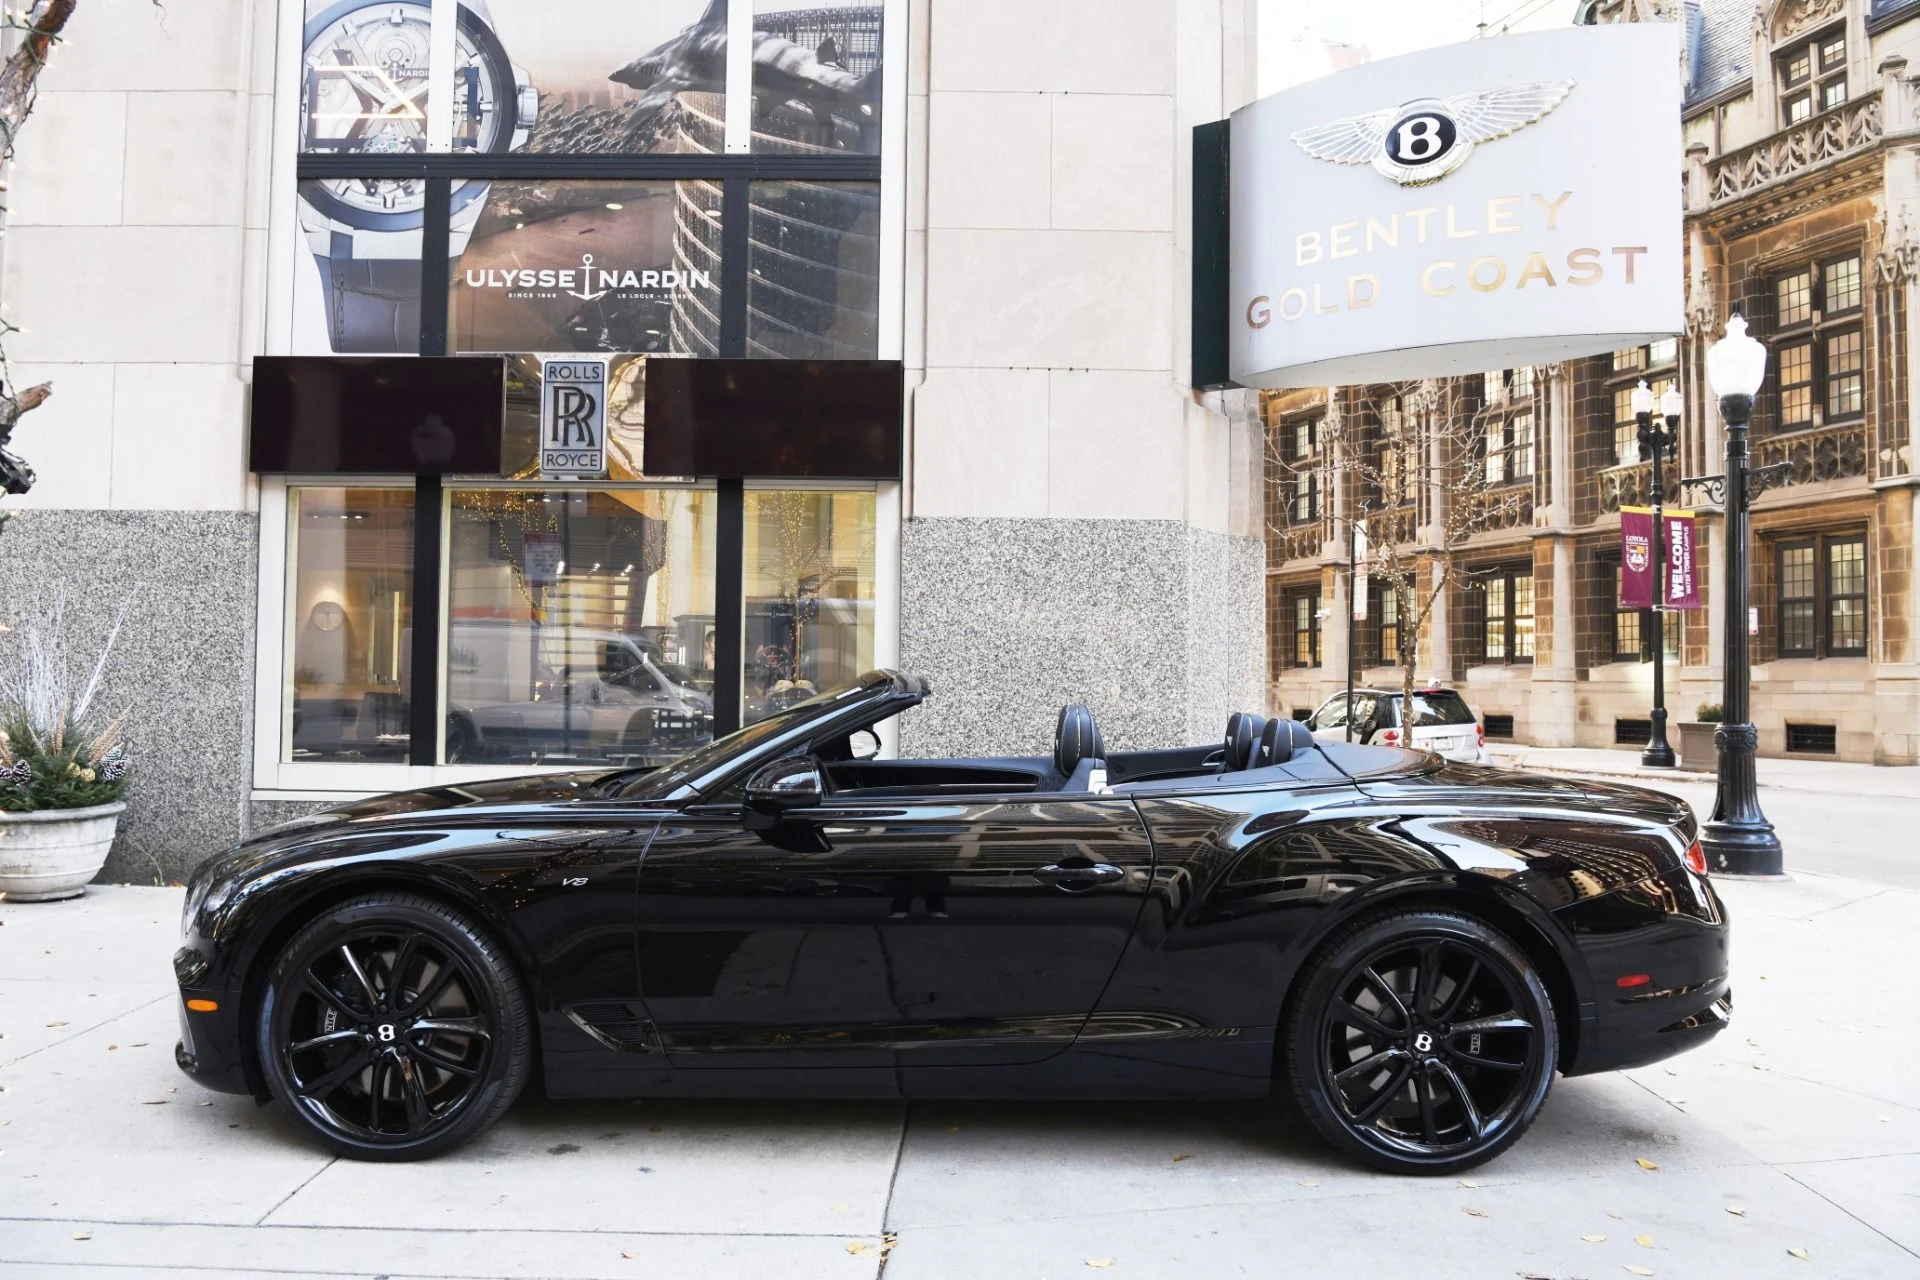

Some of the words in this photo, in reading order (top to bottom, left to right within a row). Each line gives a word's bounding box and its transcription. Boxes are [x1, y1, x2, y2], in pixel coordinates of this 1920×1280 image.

[1398, 117, 1443, 161] B
[1296, 191, 1573, 267] BENTLEY
[466, 269, 576, 288] ULYSSE
[599, 270, 710, 288] NARDIN
[1246, 273, 1380, 330] GOLD
[1421, 246, 1648, 297] COAST
[549, 366, 600, 379] ROLLS
[546, 453, 598, 467] ROYCE
[1625, 535, 1649, 543] LOYOLA
[1670, 521, 1685, 599] WELCOME
[562, 877, 589, 887] V8
